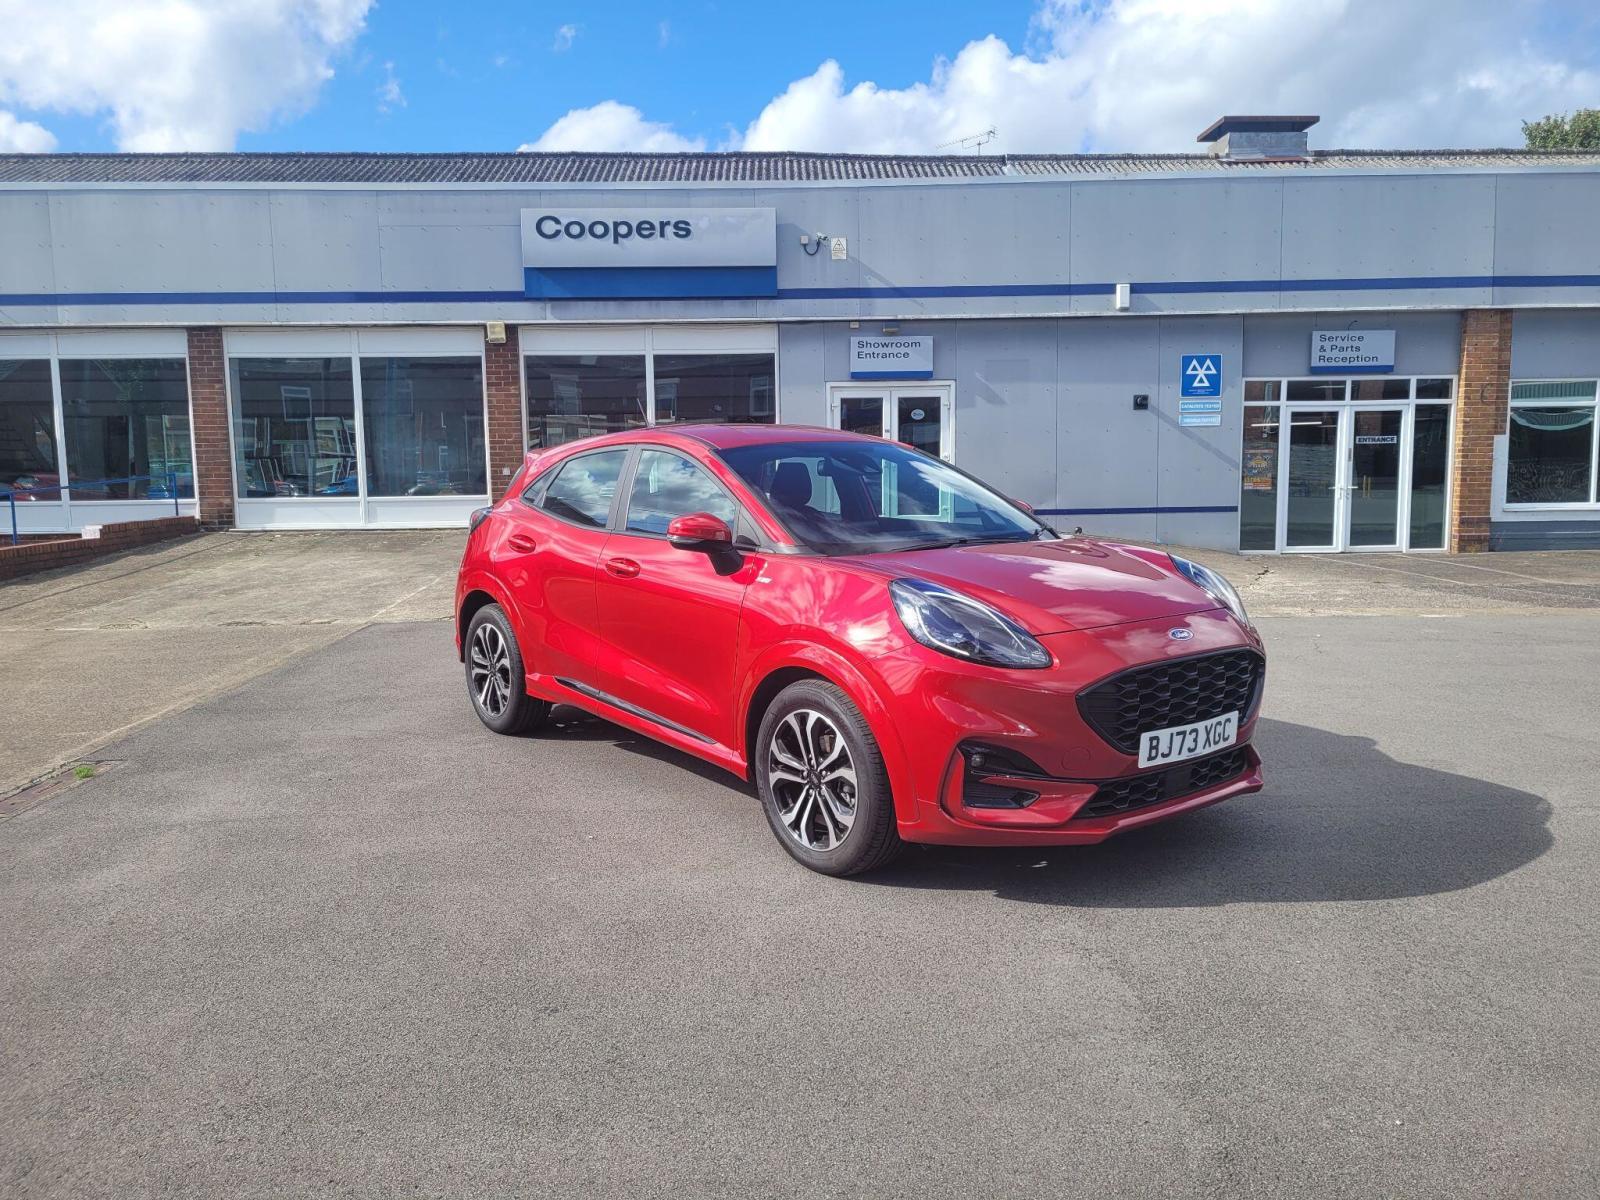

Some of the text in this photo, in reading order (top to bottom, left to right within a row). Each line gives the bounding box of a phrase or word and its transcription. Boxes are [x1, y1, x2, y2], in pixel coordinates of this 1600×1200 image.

[535, 215, 692, 244] Coopers
[1319, 334, 1364, 342] Service
[857, 339, 921, 349] Showroom
[857, 350, 910, 359] Entrance
[1318, 355, 1379, 364] Reception
[1147, 718, 1231, 761] BJ73 XGC
